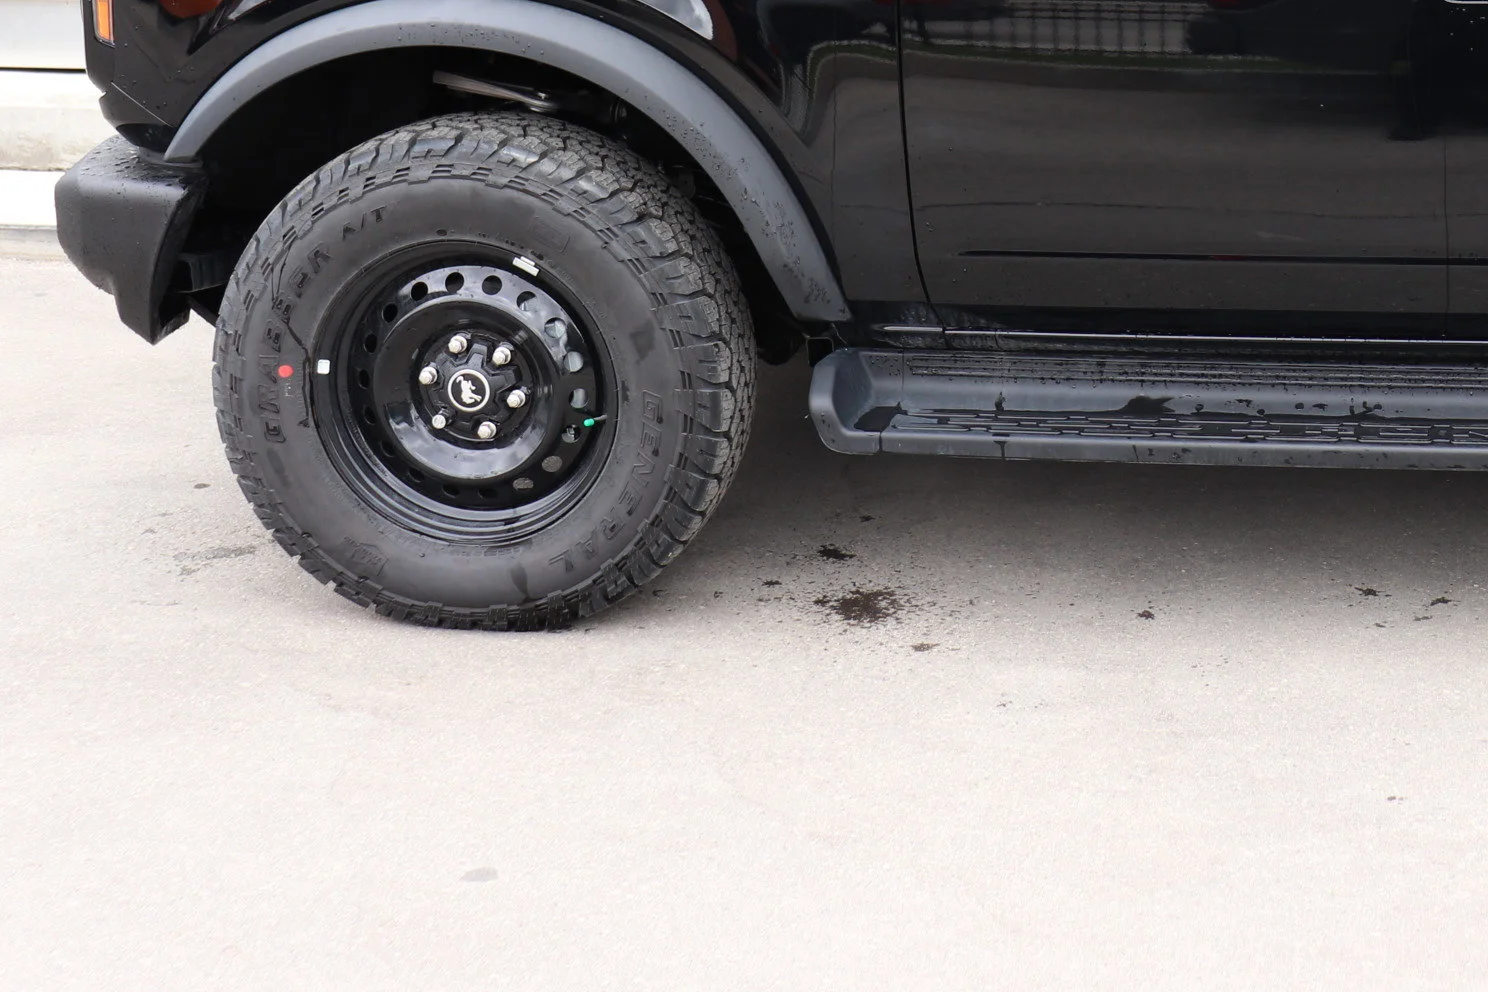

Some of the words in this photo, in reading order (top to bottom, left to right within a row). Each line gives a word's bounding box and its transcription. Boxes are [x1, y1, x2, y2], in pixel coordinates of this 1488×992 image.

[257, 240, 334, 444] GRABBER
[342, 205, 388, 242] A/T
[547, 387, 665, 575] GENERAL
